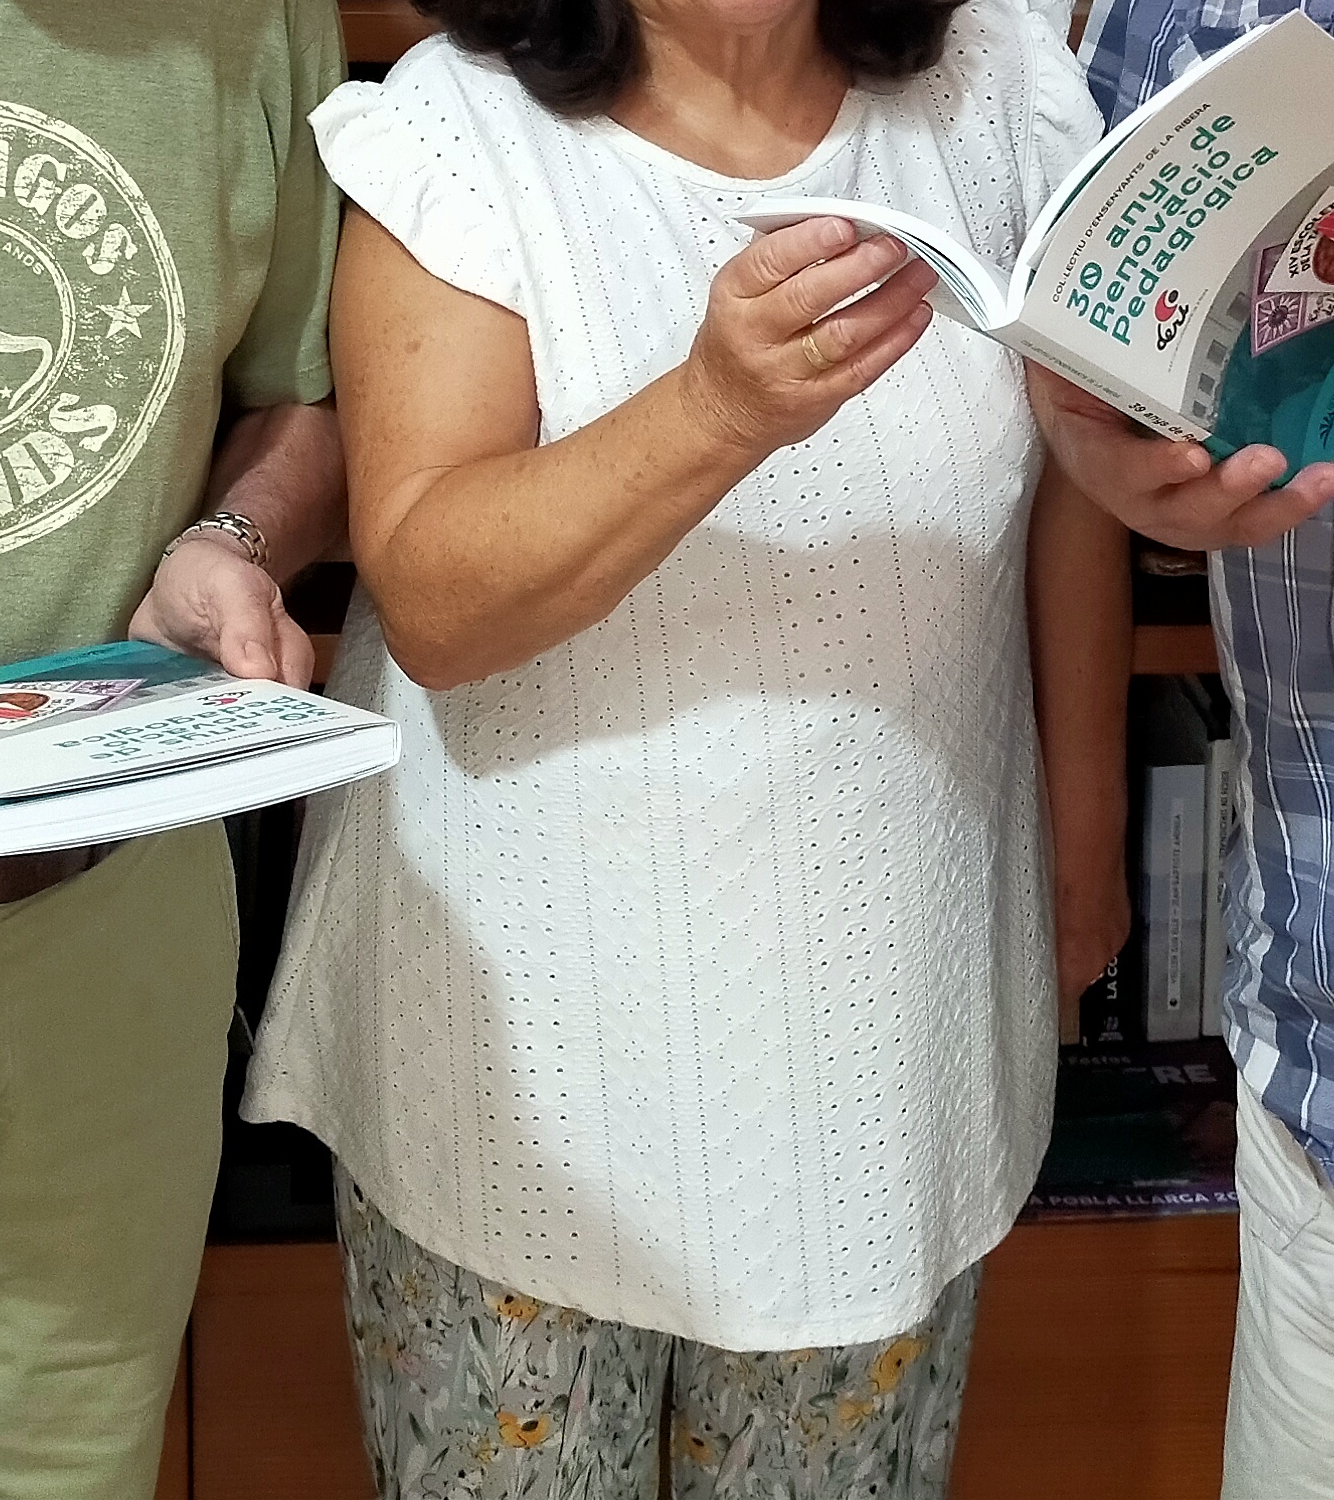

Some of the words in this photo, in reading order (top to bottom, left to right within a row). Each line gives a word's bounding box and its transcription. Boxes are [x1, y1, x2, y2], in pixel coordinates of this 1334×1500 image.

[1065, 262, 1105, 318] 30
[1105, 161, 1181, 249] anys
[1189, 112, 1236, 151] de
[1085, 160, 1146, 243] D'ENSENYANTS
[1145, 145, 1160, 164] DE
[1159, 132, 1173, 148] LA
[1173, 102, 1212, 138] RIBERA
[1089, 146, 1231, 333] Renovació
[1288, 247, 1309, 279] XIV
[1142, 409, 1169, 429] anys
[1167, 422, 1183, 436] de
[1049, 1193, 1123, 1206] POBLA
[1129, 1192, 1208, 1206] LLARGA
